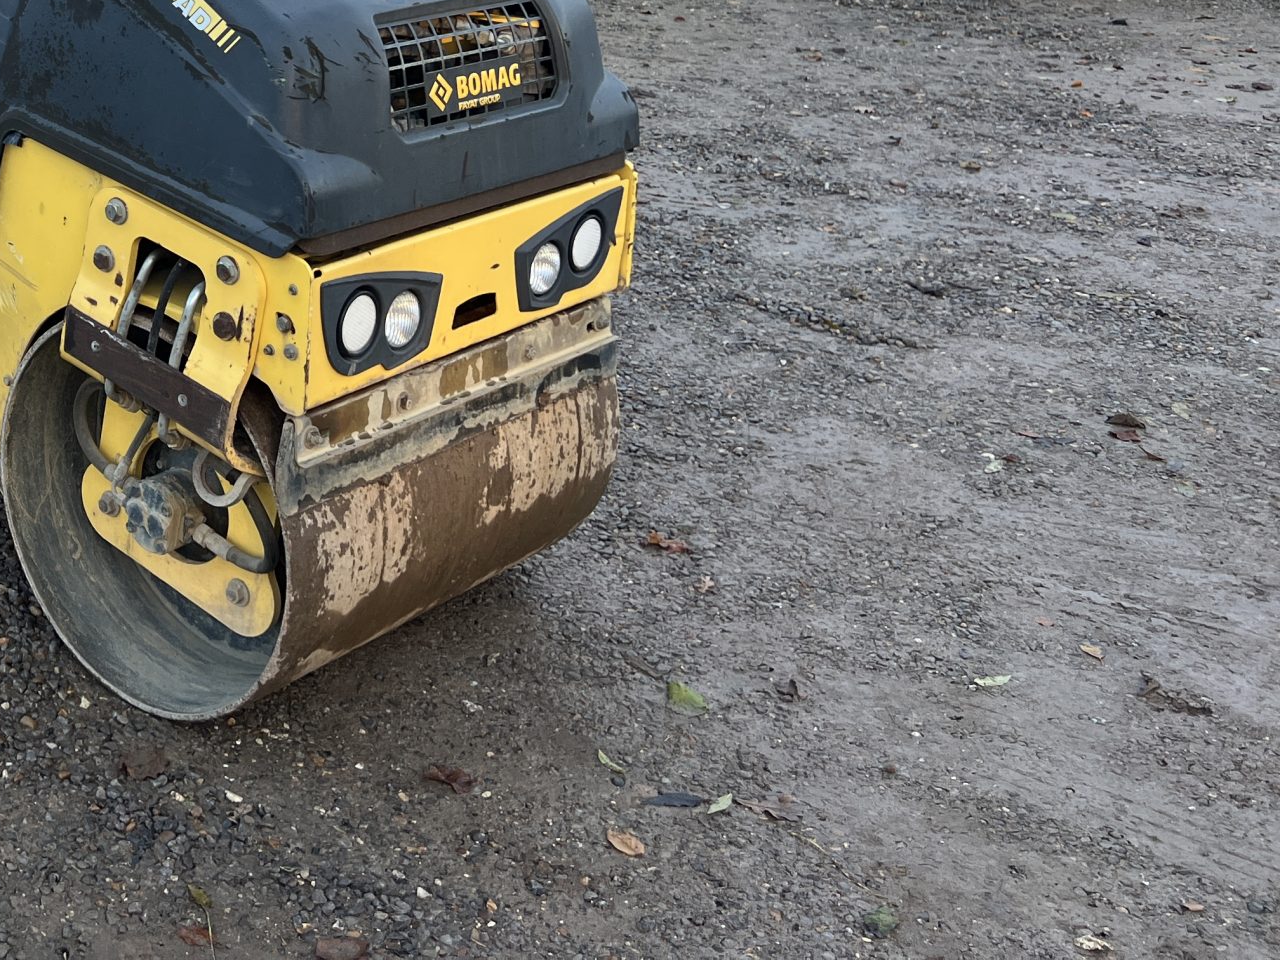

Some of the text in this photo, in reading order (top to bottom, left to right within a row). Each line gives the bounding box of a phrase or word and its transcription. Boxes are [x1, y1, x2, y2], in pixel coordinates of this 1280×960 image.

[455, 62, 522, 100] BOMAG
[458, 93, 501, 111] FAYAT GROUP
